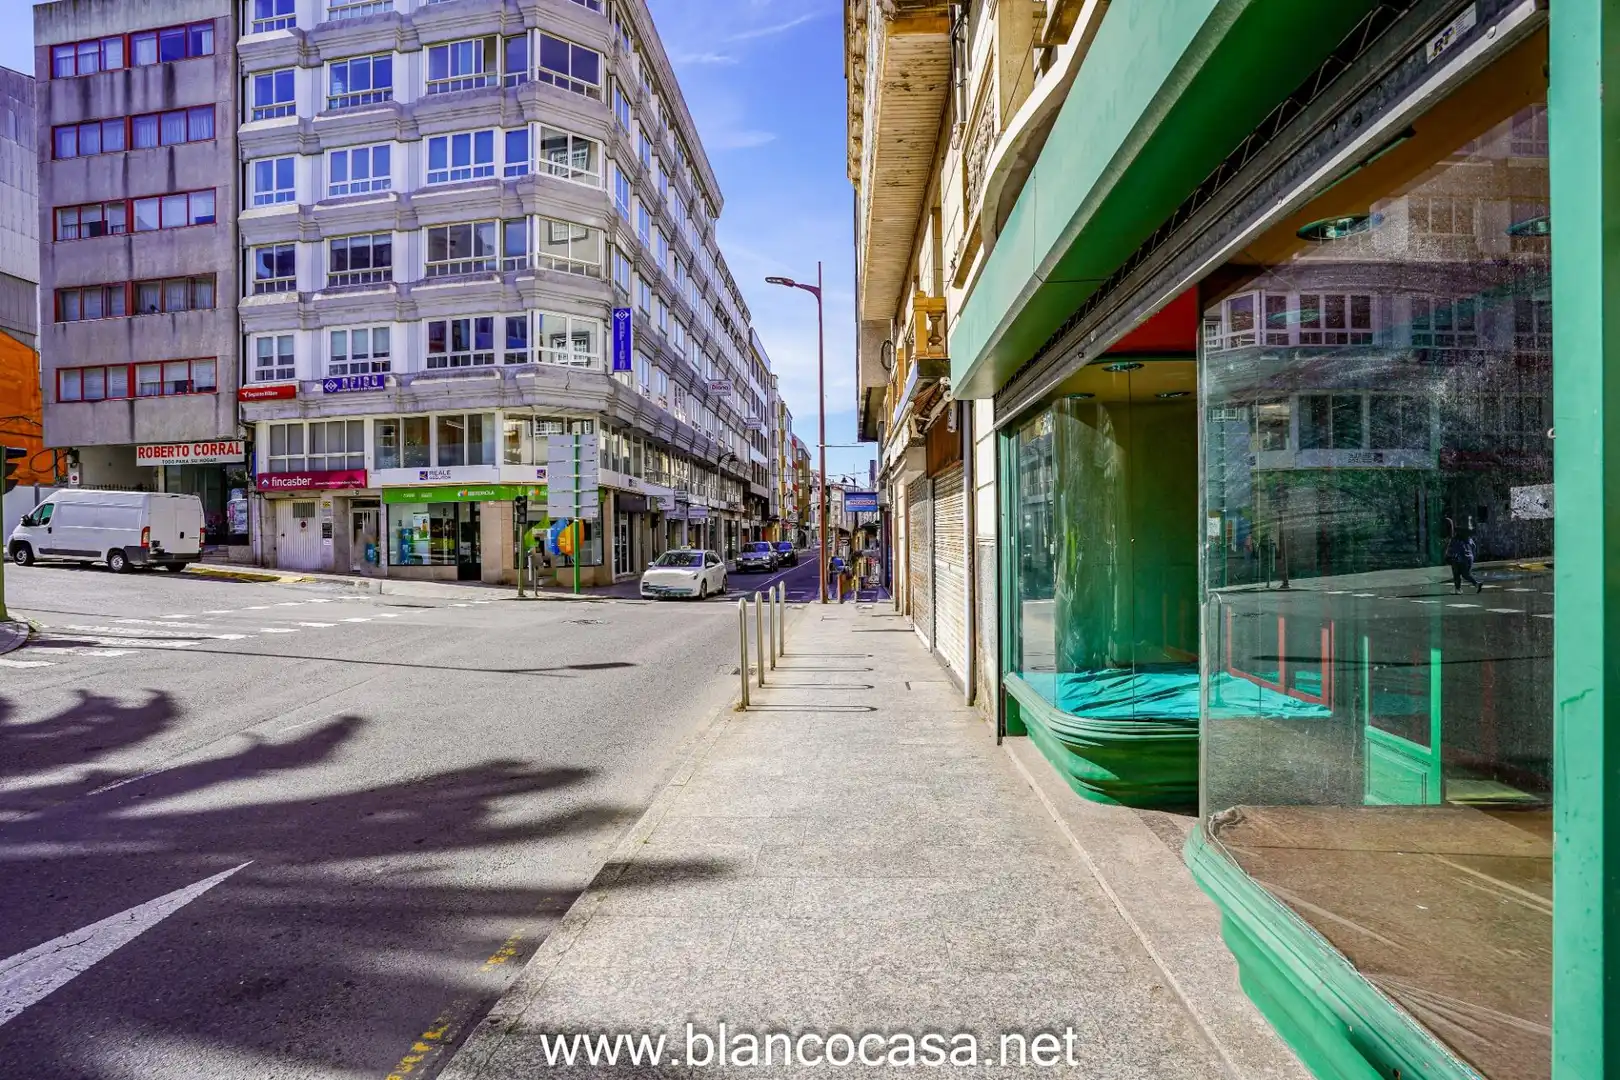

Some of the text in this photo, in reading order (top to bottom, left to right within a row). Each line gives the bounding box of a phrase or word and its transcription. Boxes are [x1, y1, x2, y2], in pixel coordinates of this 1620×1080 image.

[138, 442, 243, 459] ROBERTO CORRAL
[271, 476, 312, 487] fincasber
